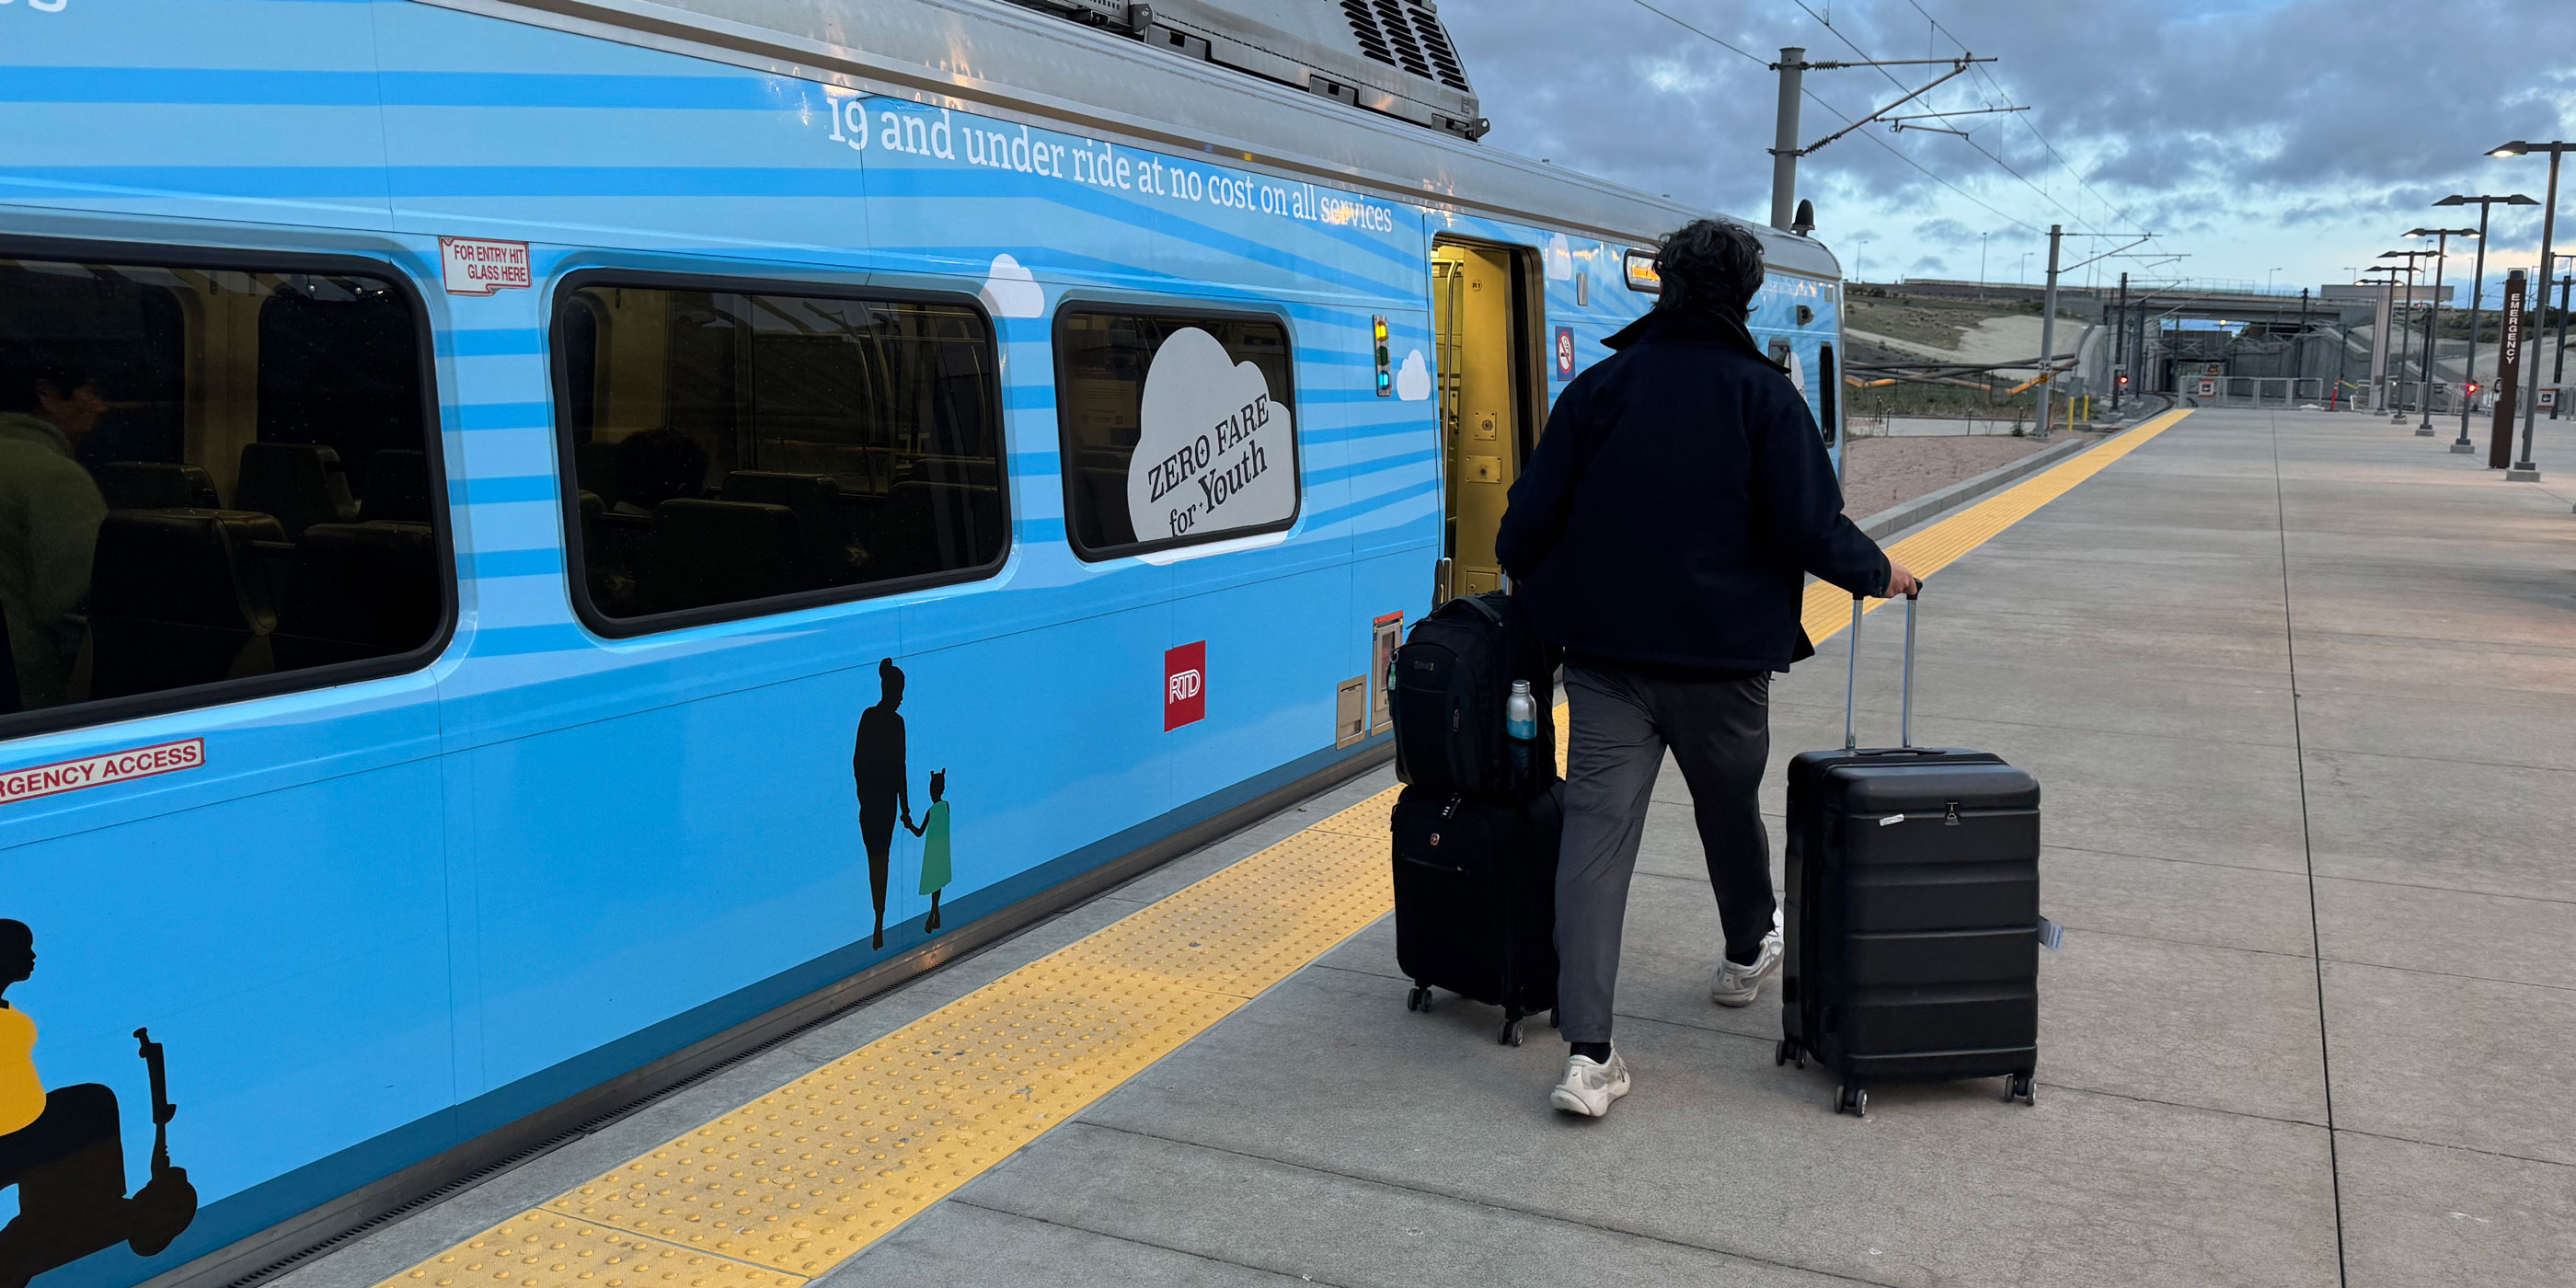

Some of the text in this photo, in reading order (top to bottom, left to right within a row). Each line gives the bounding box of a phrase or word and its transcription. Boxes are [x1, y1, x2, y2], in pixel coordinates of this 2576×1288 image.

[826, 98, 1394, 233] 19 and under ride at no cost on all services
[454, 244, 524, 264] FOR ENTRY HIT
[467, 263, 527, 282] GLASS HERE
[2506, 293, 2520, 364] EMERGENCY
[2040, 362, 2052, 371] 35
[1147, 393, 1270, 504] ZERO FARE
[1169, 439, 1269, 538] for Youth
[1169, 669, 1201, 705] RTD
[102, 744, 197, 778] ACCESS
